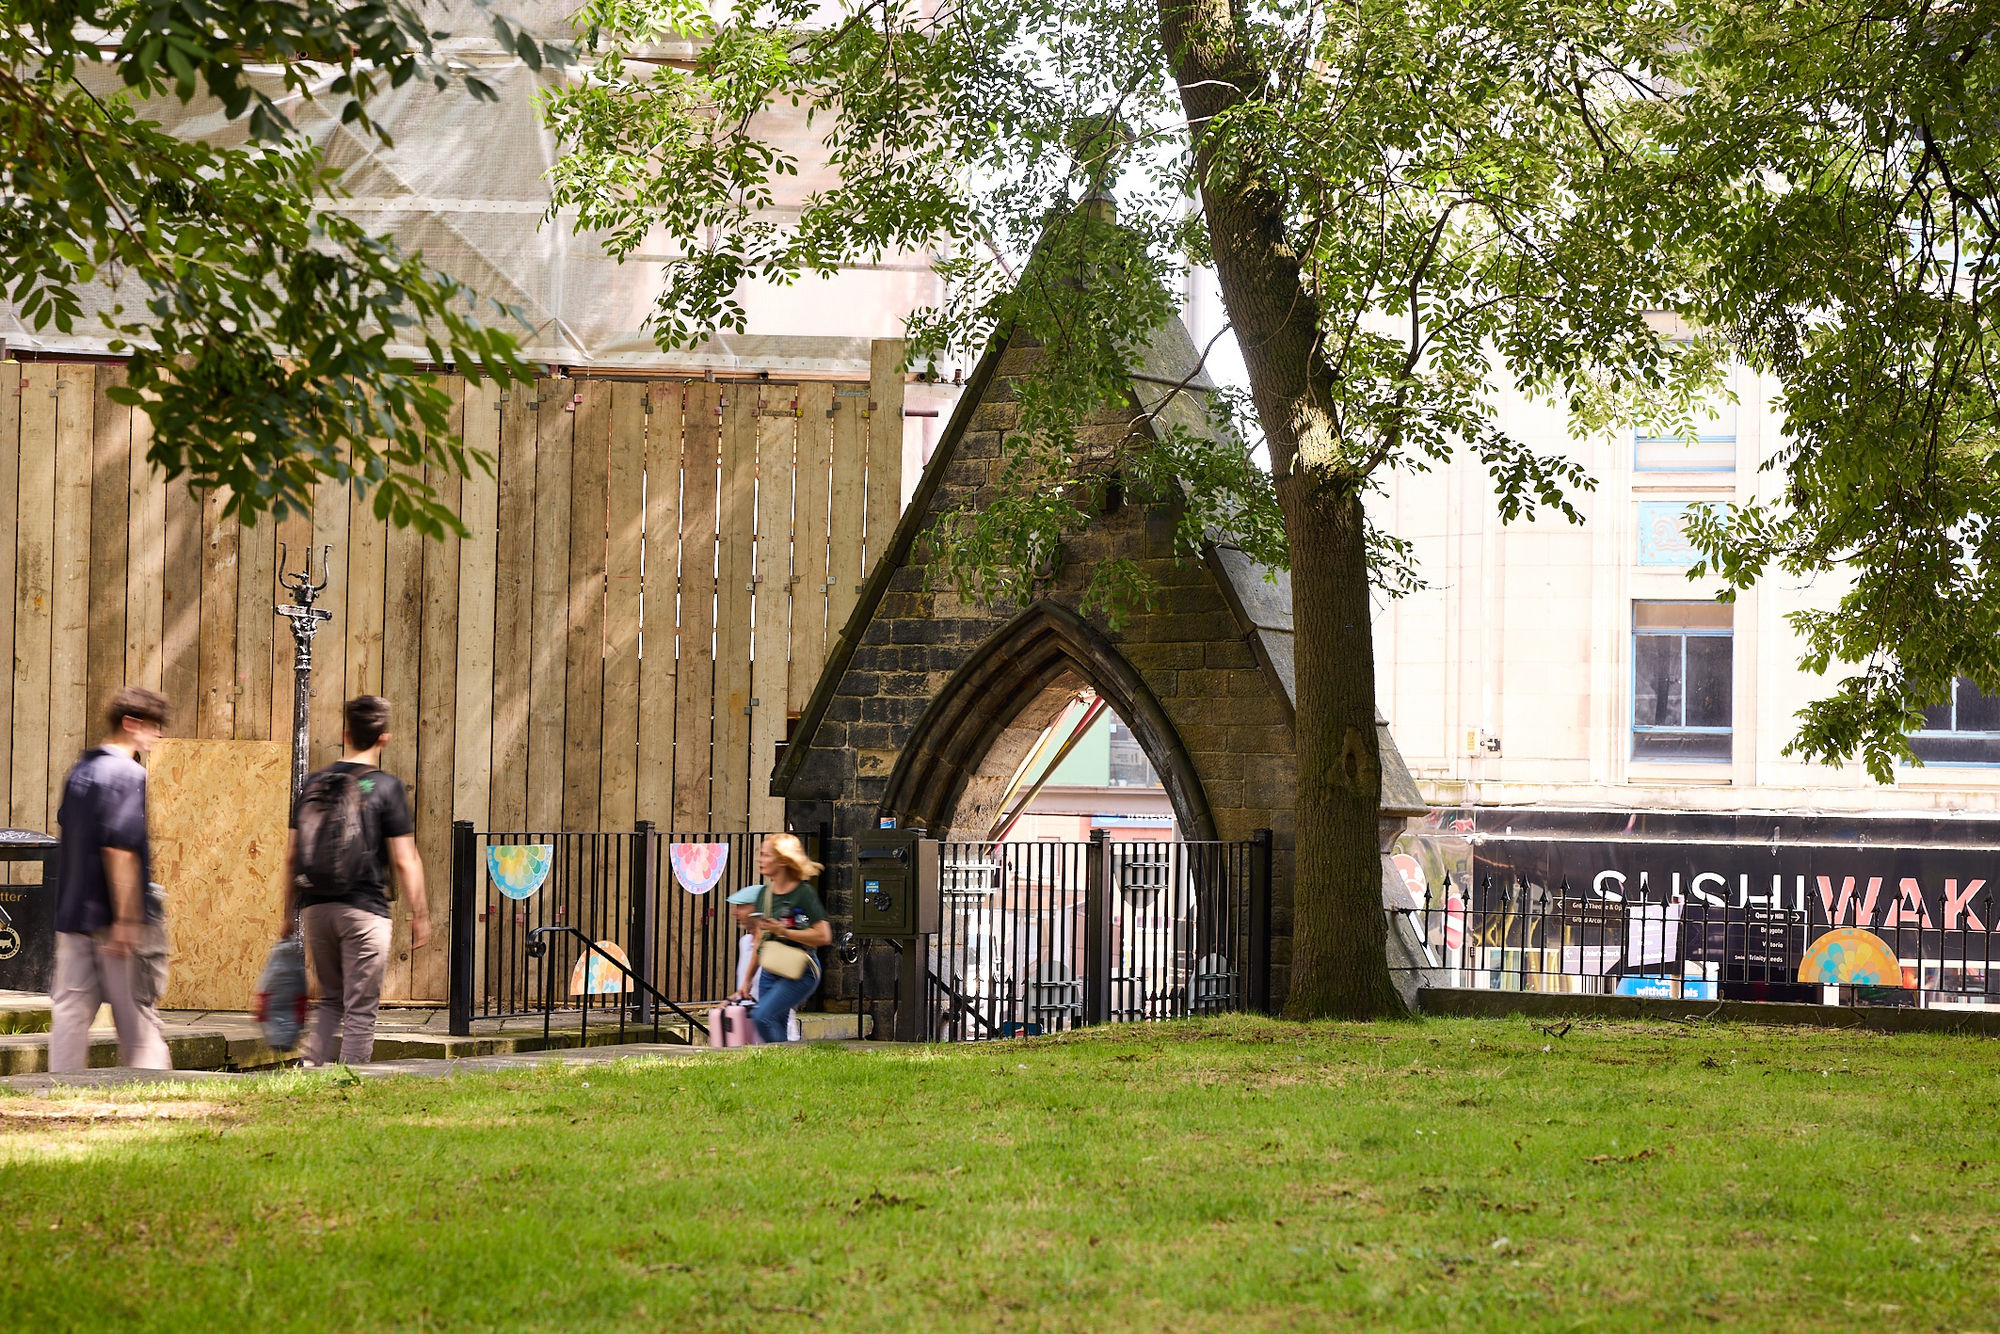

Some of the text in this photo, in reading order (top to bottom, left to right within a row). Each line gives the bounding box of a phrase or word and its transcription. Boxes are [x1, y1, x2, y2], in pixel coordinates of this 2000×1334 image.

[0, 892, 22, 902] tter
[1572, 901, 1588, 909] Grad
[1589, 902, 1609, 910] Theae
[1755, 912, 1774, 920] Quary
[1760, 926, 1784, 935] Brgate
[1636, 986, 1698, 998] withdrals
